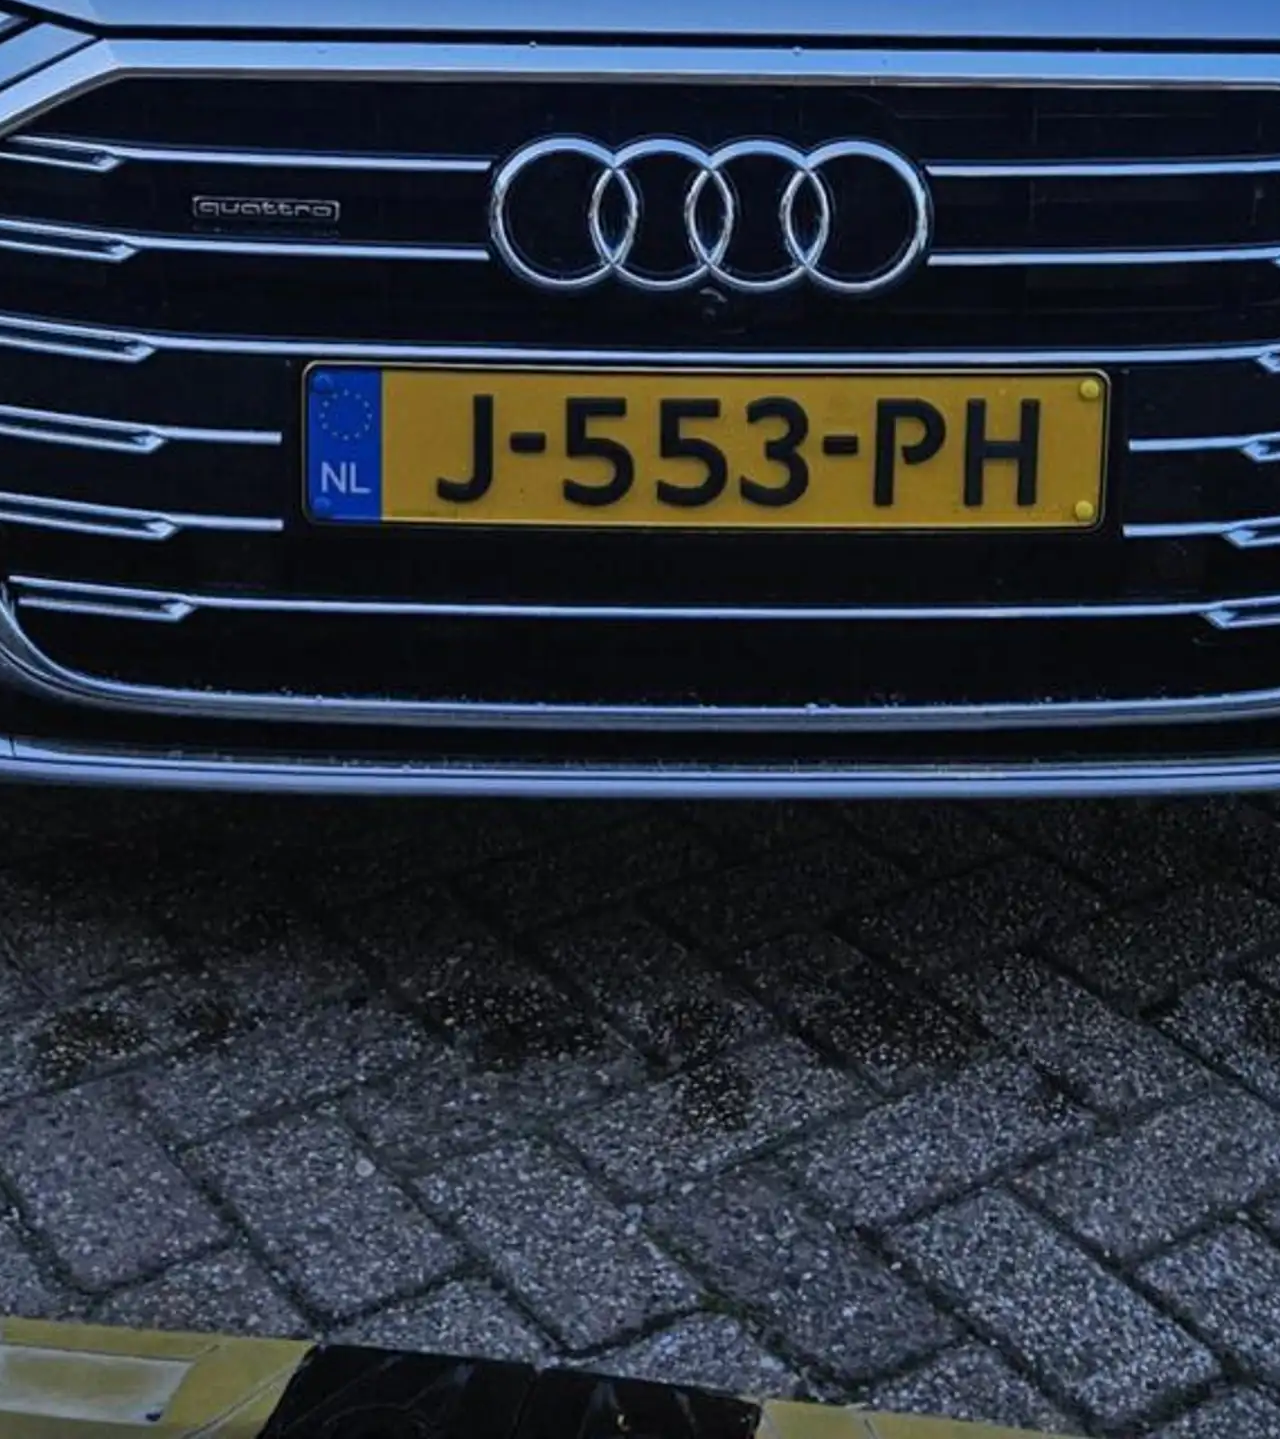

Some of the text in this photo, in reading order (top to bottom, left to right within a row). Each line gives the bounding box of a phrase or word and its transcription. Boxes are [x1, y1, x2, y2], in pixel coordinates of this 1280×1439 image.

[198, 201, 333, 217] quattro
[435, 394, 1041, 508] J-553-PH
[320, 461, 371, 494] NL
